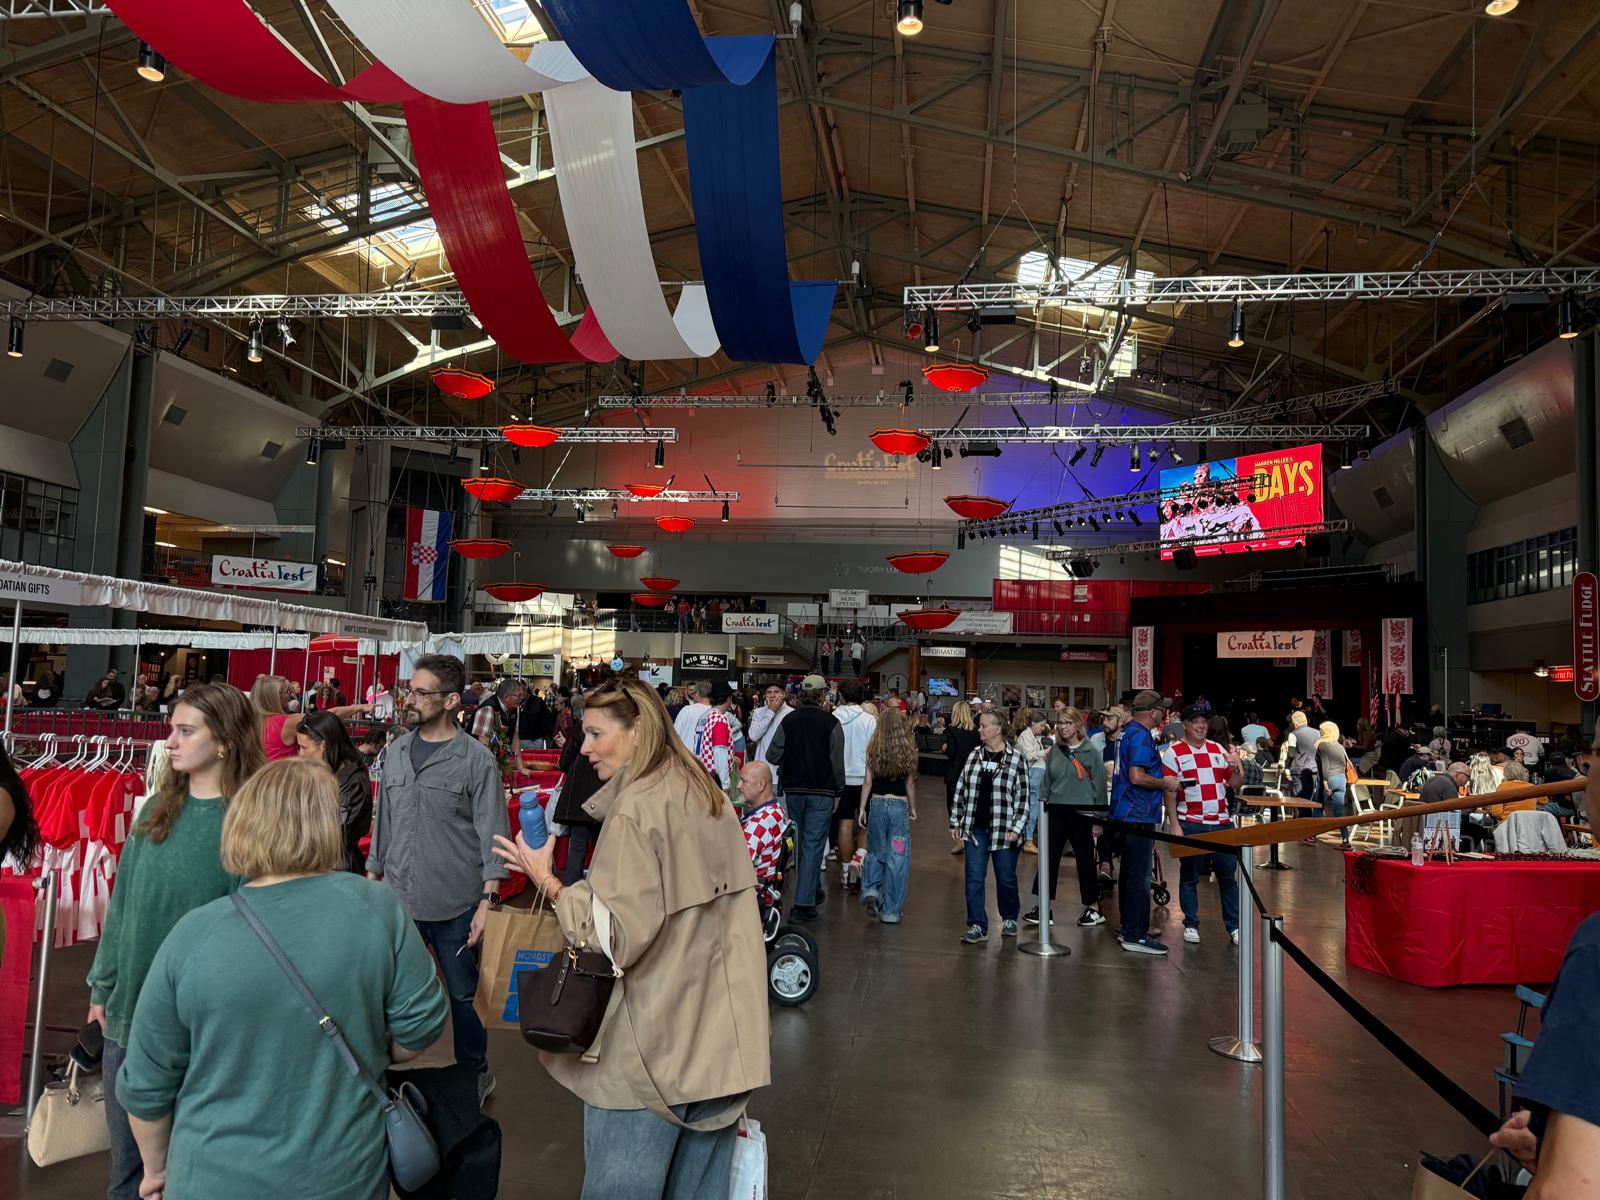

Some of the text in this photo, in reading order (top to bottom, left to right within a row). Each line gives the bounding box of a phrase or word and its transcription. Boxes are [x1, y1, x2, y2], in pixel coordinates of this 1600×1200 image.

[1255, 460, 1314, 503] DAYS
[28, 582, 50, 595] GIFTS
[1579, 583, 1594, 693] SEATTLE FUDGE
[922, 648, 965, 656] INFORMATION
[685, 656, 698, 664] BIG
[699, 655, 725, 665] MIKE'S
